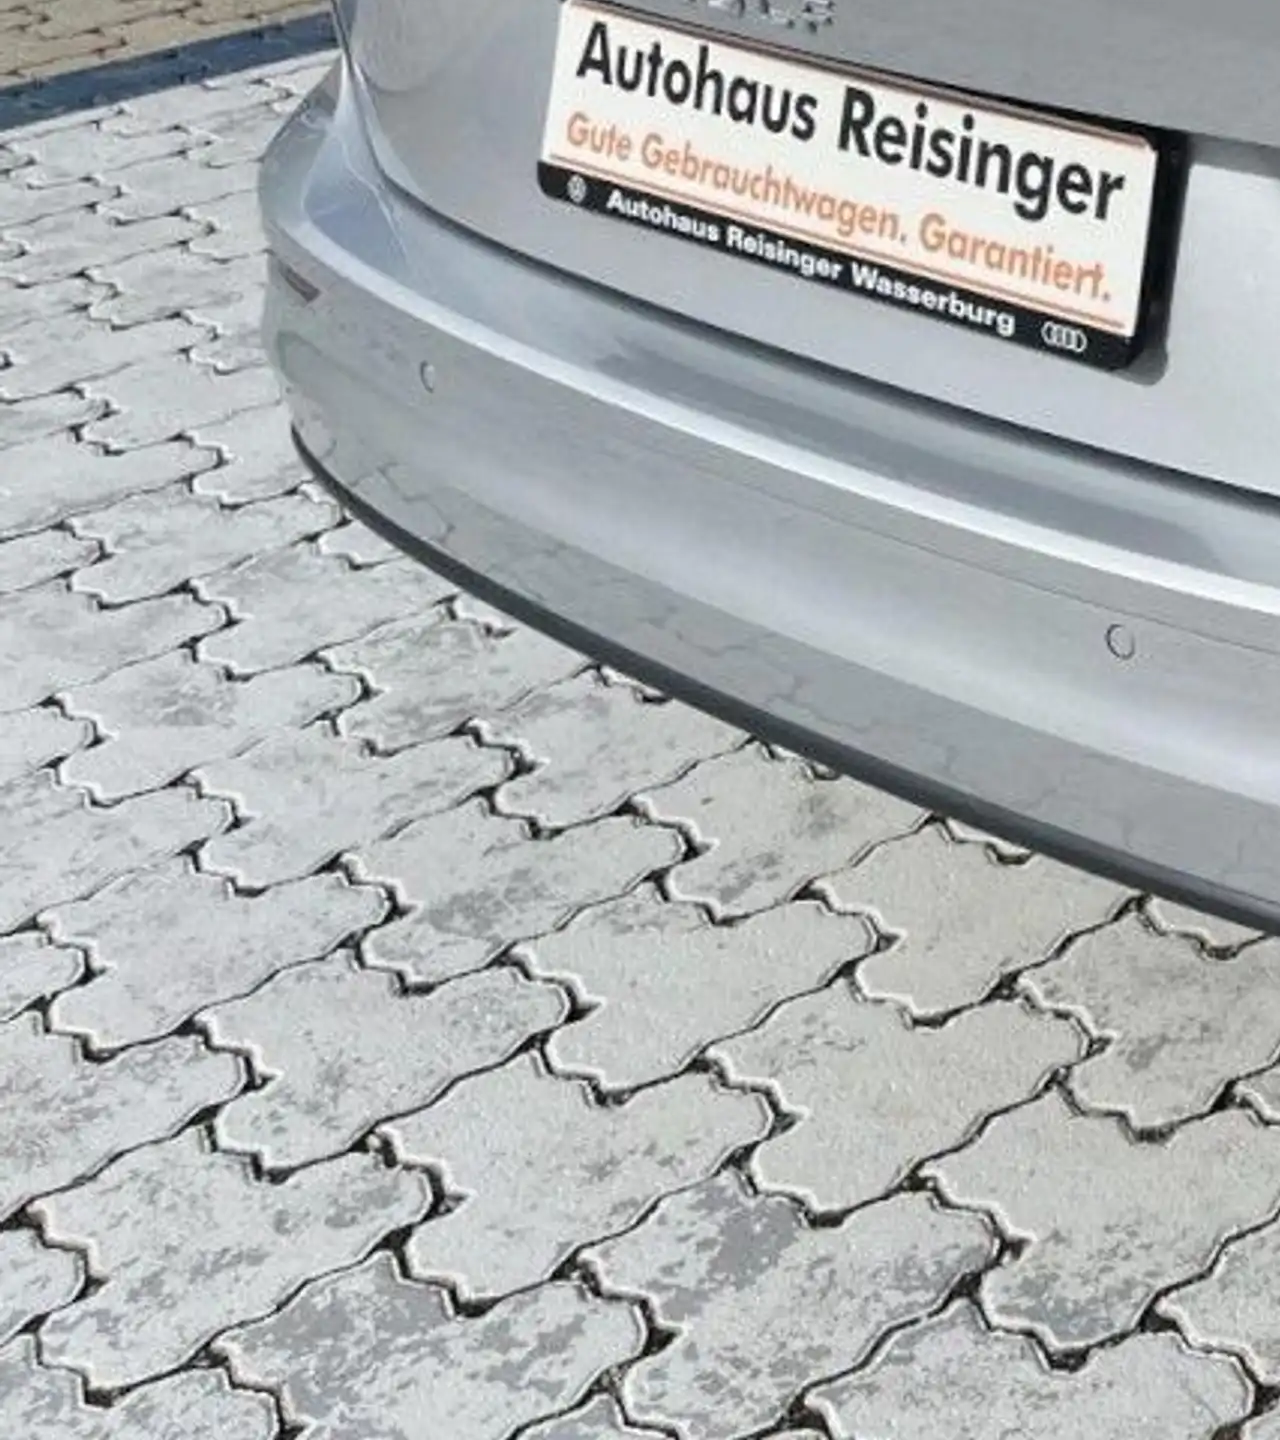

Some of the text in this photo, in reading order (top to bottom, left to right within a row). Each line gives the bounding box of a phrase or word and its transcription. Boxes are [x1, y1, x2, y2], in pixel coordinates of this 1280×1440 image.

[566, 112, 1111, 302] Gute Gebrauchtwagen. Garantiert.
[576, 21, 1125, 222] Autohaus Reisinger
[606, 189, 720, 242] Autohaus
[726, 226, 843, 281] Reisinger
[851, 262, 1016, 337] Wasserburg
